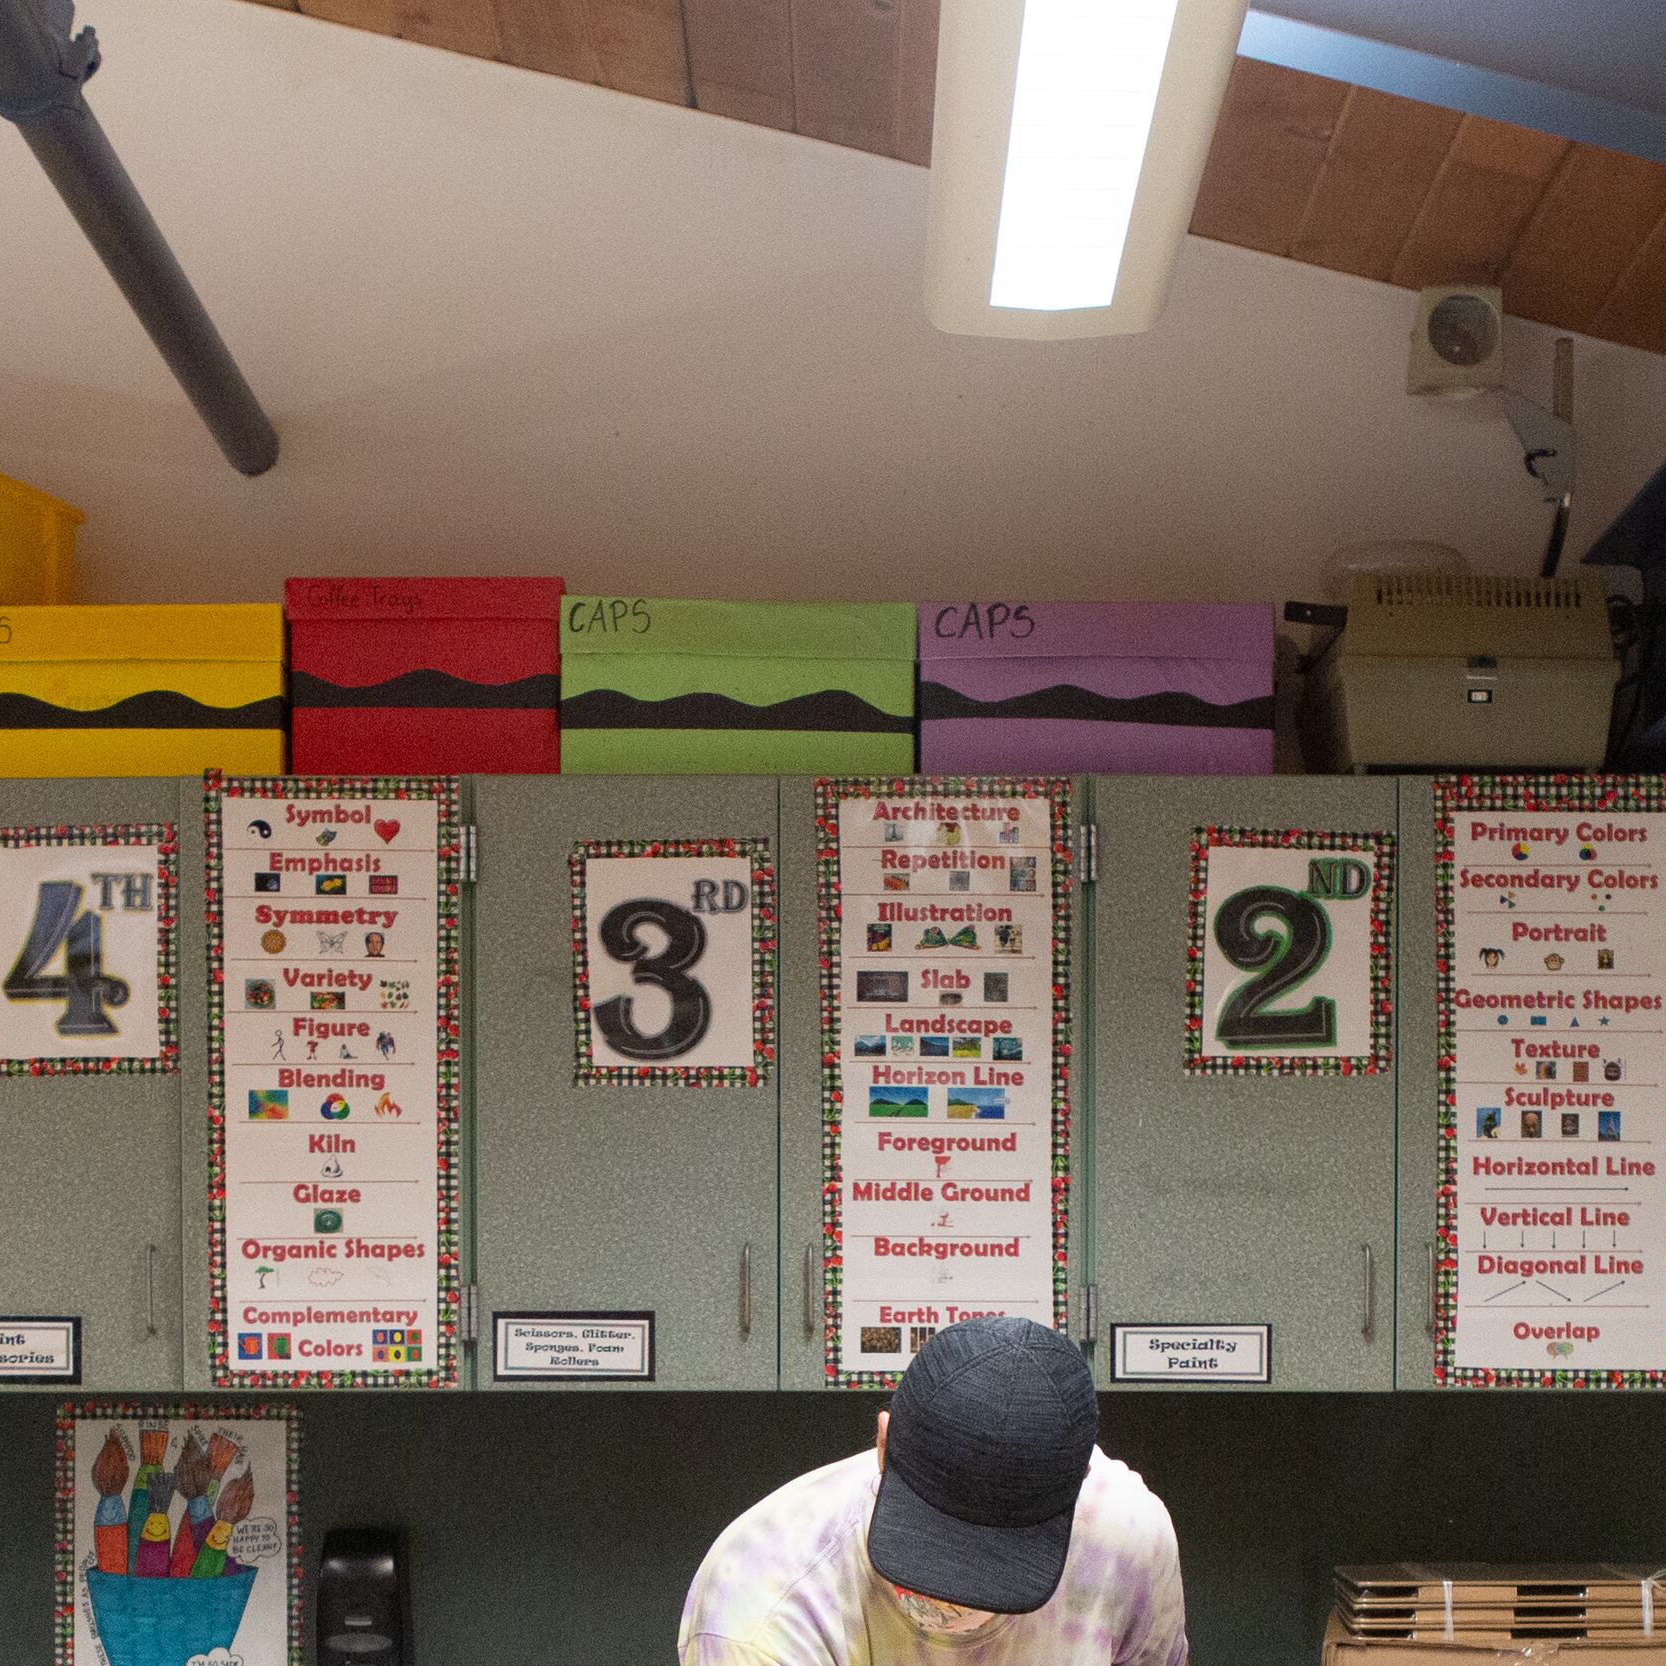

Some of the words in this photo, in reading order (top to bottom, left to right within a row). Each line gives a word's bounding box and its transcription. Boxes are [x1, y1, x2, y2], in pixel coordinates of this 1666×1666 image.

[567, 598, 653, 635] CAPS
[933, 603, 1037, 640] CAPS
[285, 804, 372, 827] Symbol
[873, 801, 1021, 822] Architecture
[1470, 822, 1570, 845] Primary
[1575, 822, 1648, 843] Colors
[269, 852, 382, 874] Emphasis
[880, 849, 1006, 871] Repetition
[1459, 869, 1581, 891] Secondary
[1587, 869, 1658, 889] Colors
[255, 906, 399, 928] Symmetry
[878, 903, 1013, 922] Illustration
[1511, 922, 1607, 943] Portrait
[283, 968, 373, 991] Variety
[921, 968, 971, 989] Slab
[1453, 989, 1576, 1009] Geometric
[1582, 989, 1663, 1012] Shapes
[293, 1017, 370, 1039] Figure
[885, 1015, 1013, 1036] Landscape
[1511, 1038, 1601, 1059] Texture
[278, 1068, 385, 1091] Blending
[871, 1065, 966, 1086] Horizon
[973, 1066, 1024, 1086] Line
[1504, 1087, 1615, 1109] Sculpture
[308, 1134, 356, 1153] Kiln
[877, 1131, 1017, 1153] Foreground
[1472, 1156, 1599, 1176] Horizontal
[1605, 1156, 1656, 1176] Line
[293, 1184, 361, 1204] Glaze
[852, 1183, 934, 1202] Middle
[940, 1183, 1031, 1202] Ground
[1480, 1206, 1573, 1227] Vertical
[1580, 1206, 1630, 1227] Line
[241, 1239, 337, 1261] Organic
[344, 1239, 425, 1261] Shapes
[874, 1237, 1020, 1259] Background
[1477, 1255, 1587, 1278] Diagonal
[1593, 1255, 1644, 1274] Line
[242, 1306, 419, 1328] Complementary
[879, 1306, 938, 1324] Earth
[1513, 1321, 1601, 1343] Overlap
[298, 1338, 363, 1358] Colors
[588, 1343, 624, 1353] Foam
[1149, 1338, 1237, 1352] Specialty
[550, 1356, 599, 1366] Rollers
[1168, 1357, 1218, 1369] Paint
